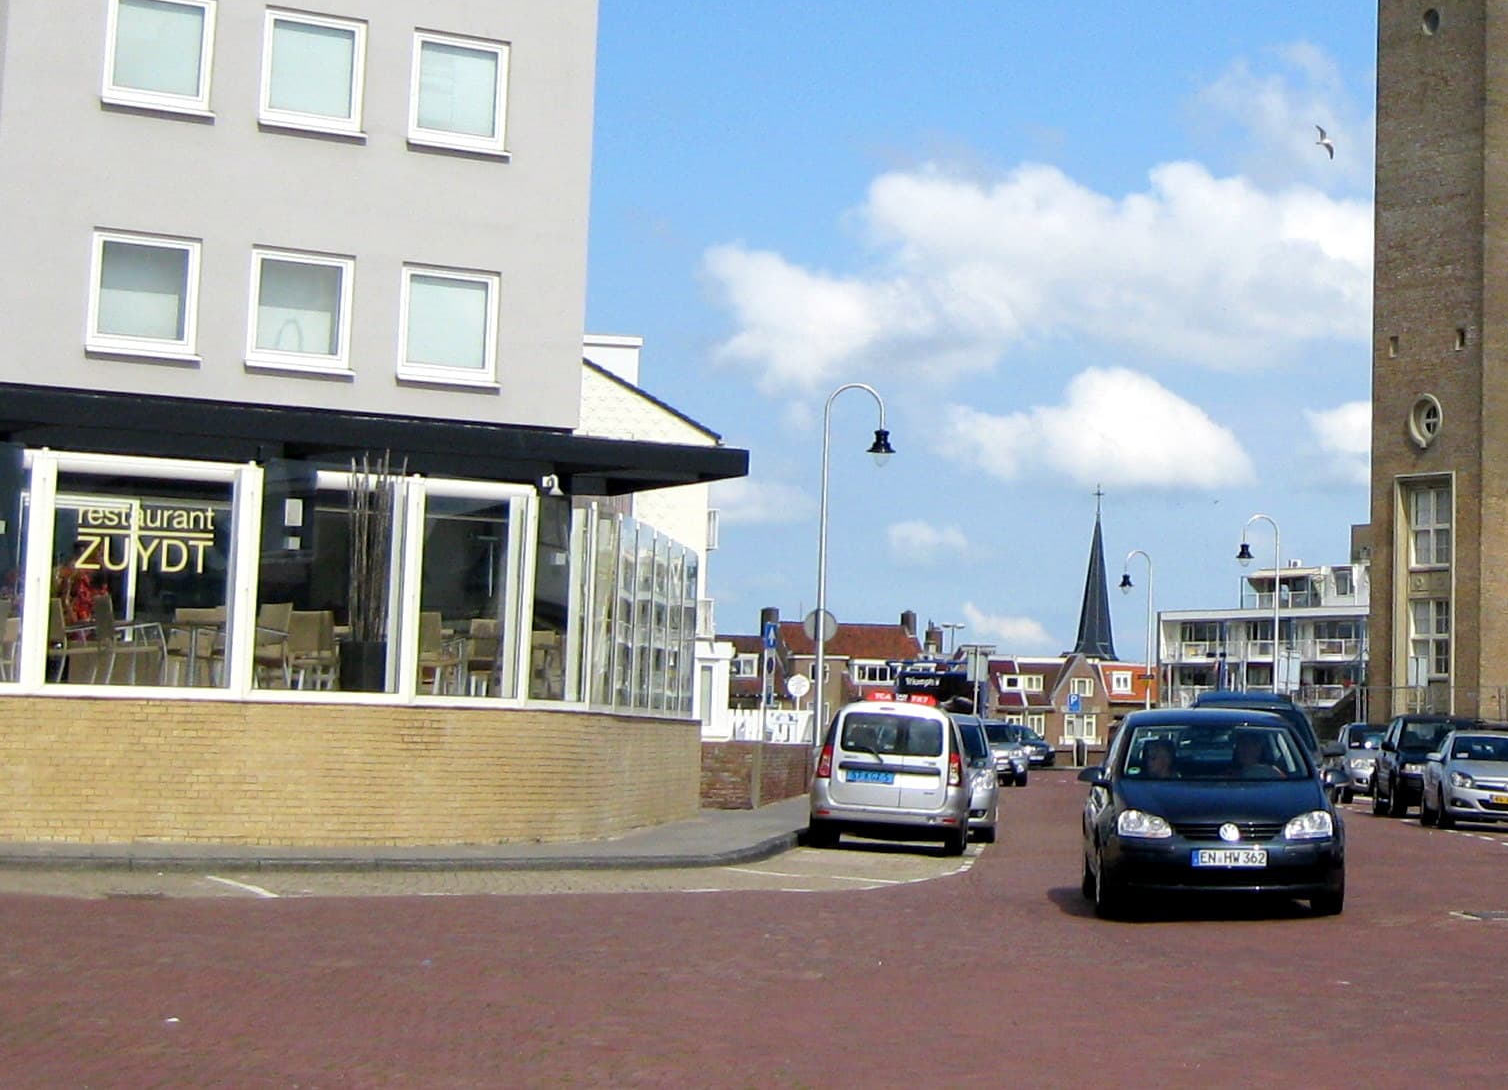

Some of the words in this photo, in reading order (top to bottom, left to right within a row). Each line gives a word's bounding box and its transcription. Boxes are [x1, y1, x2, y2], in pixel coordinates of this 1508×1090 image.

[77, 507, 216, 530] restaurant
[74, 535, 214, 574] ZUYDT
[1200, 852, 1216, 863] EN
[1224, 852, 1240, 863] HW
[1243, 852, 1265, 864] 362
